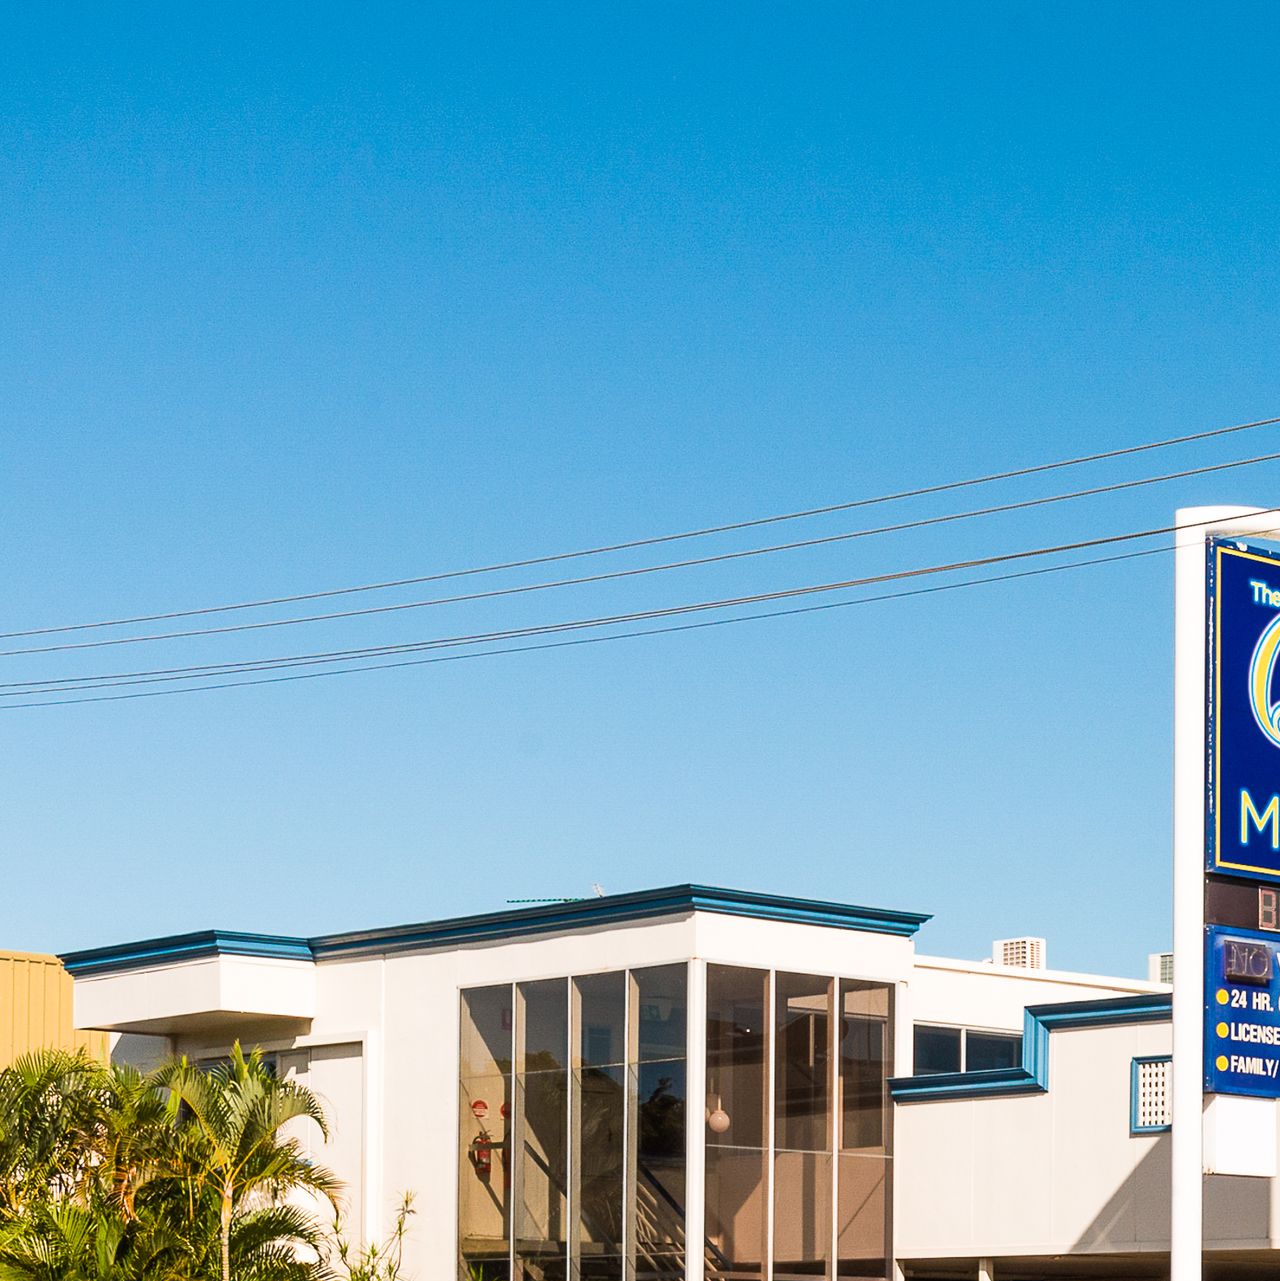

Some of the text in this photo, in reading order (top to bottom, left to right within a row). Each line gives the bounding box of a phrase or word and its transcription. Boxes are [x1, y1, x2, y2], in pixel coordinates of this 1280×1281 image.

[1231, 988, 1248, 1008] 24
[1252, 991, 1274, 1012] HR.
[1230, 1055, 1280, 1079] FAMILY/
